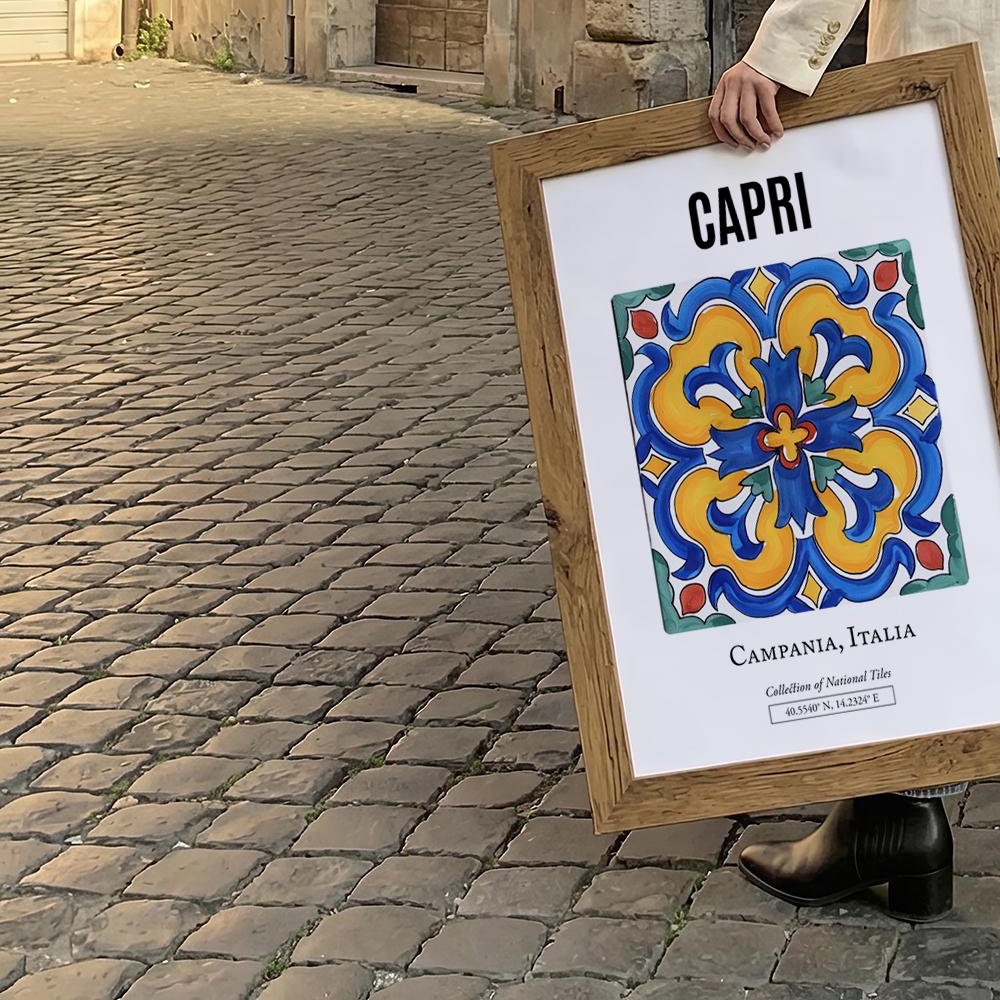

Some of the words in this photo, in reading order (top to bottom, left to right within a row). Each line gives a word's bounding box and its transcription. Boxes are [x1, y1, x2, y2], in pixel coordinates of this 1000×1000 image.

[688, 171, 812, 250] CAPRI
[766, 682, 811, 698] Collection
[813, 677, 824, 693] of
[826, 670, 867, 688] National
[869, 667, 892, 681] Tiles
[823, 700, 834, 711] N,
[873, 693, 880, 703] E
